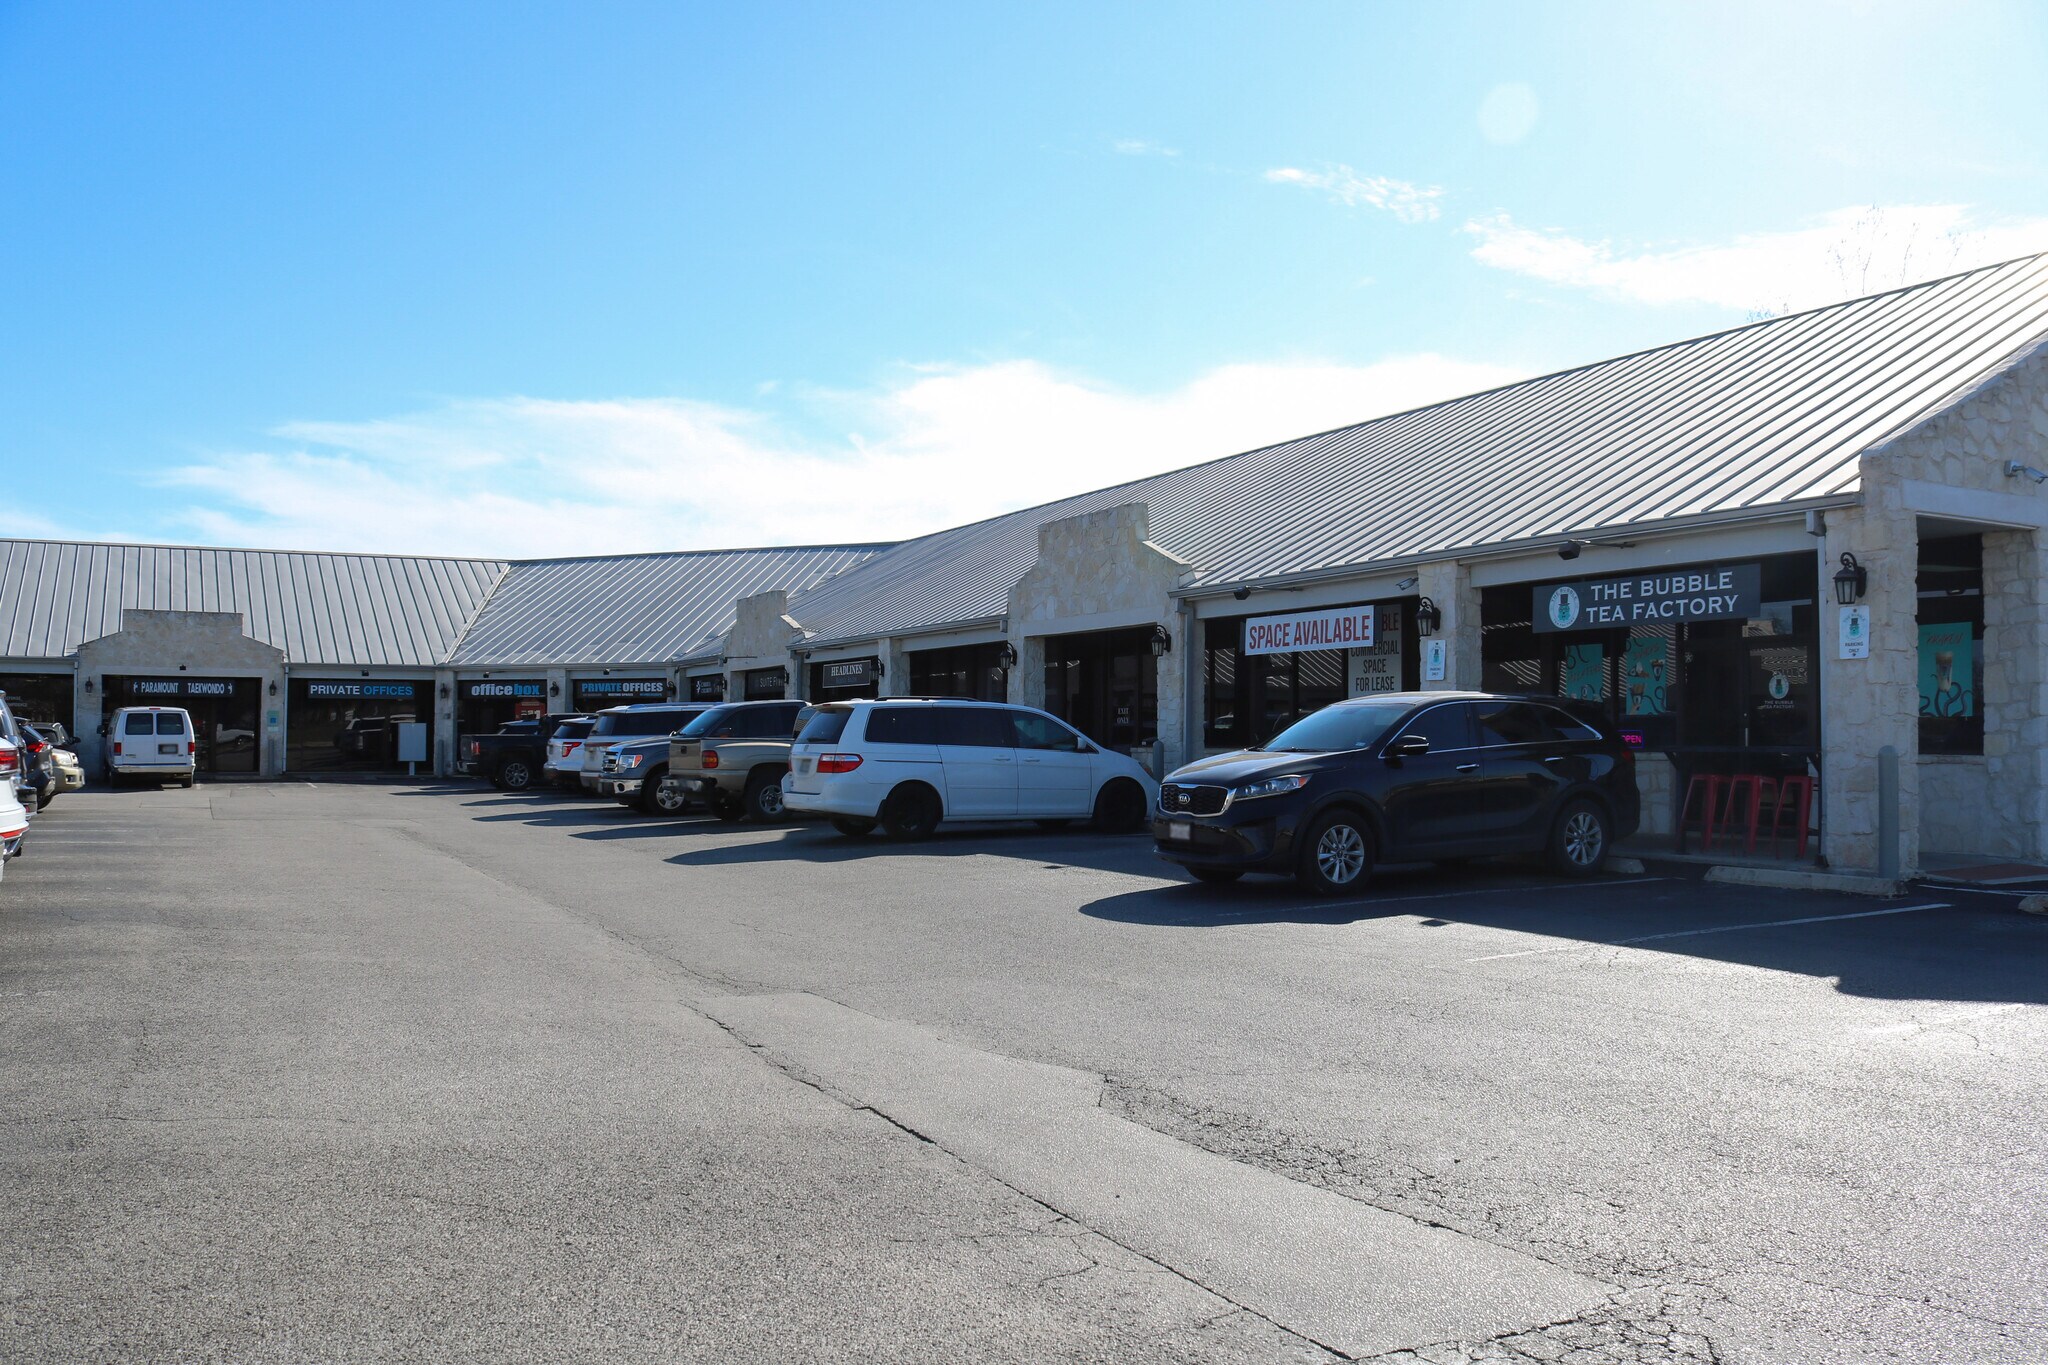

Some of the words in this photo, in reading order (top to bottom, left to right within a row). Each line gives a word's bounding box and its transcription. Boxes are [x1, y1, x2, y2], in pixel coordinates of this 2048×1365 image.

[1590, 581, 1632, 601] THE
[1640, 571, 1733, 597] BUBBLE
[1586, 605, 1625, 623] TEA
[1633, 595, 1739, 620] FACTORY
[1249, 622, 1290, 649] SPACE
[1293, 615, 1370, 646] AVAILABLE
[1350, 640, 1400, 657] COMMERCIAL
[831, 663, 863, 677] HEADLINES
[1363, 659, 1387, 674] SPACE
[141, 682, 179, 694] PARAMOUNT
[187, 682, 225, 694] TAEKWONDO
[310, 685, 361, 695] PRIVATE
[363, 685, 413, 696] OFFICES
[581, 682, 621, 692] PRIVATE
[622, 682, 664, 692] OFFICES
[1355, 677, 1370, 692] FOR
[1372, 676, 1395, 691] LEASE
